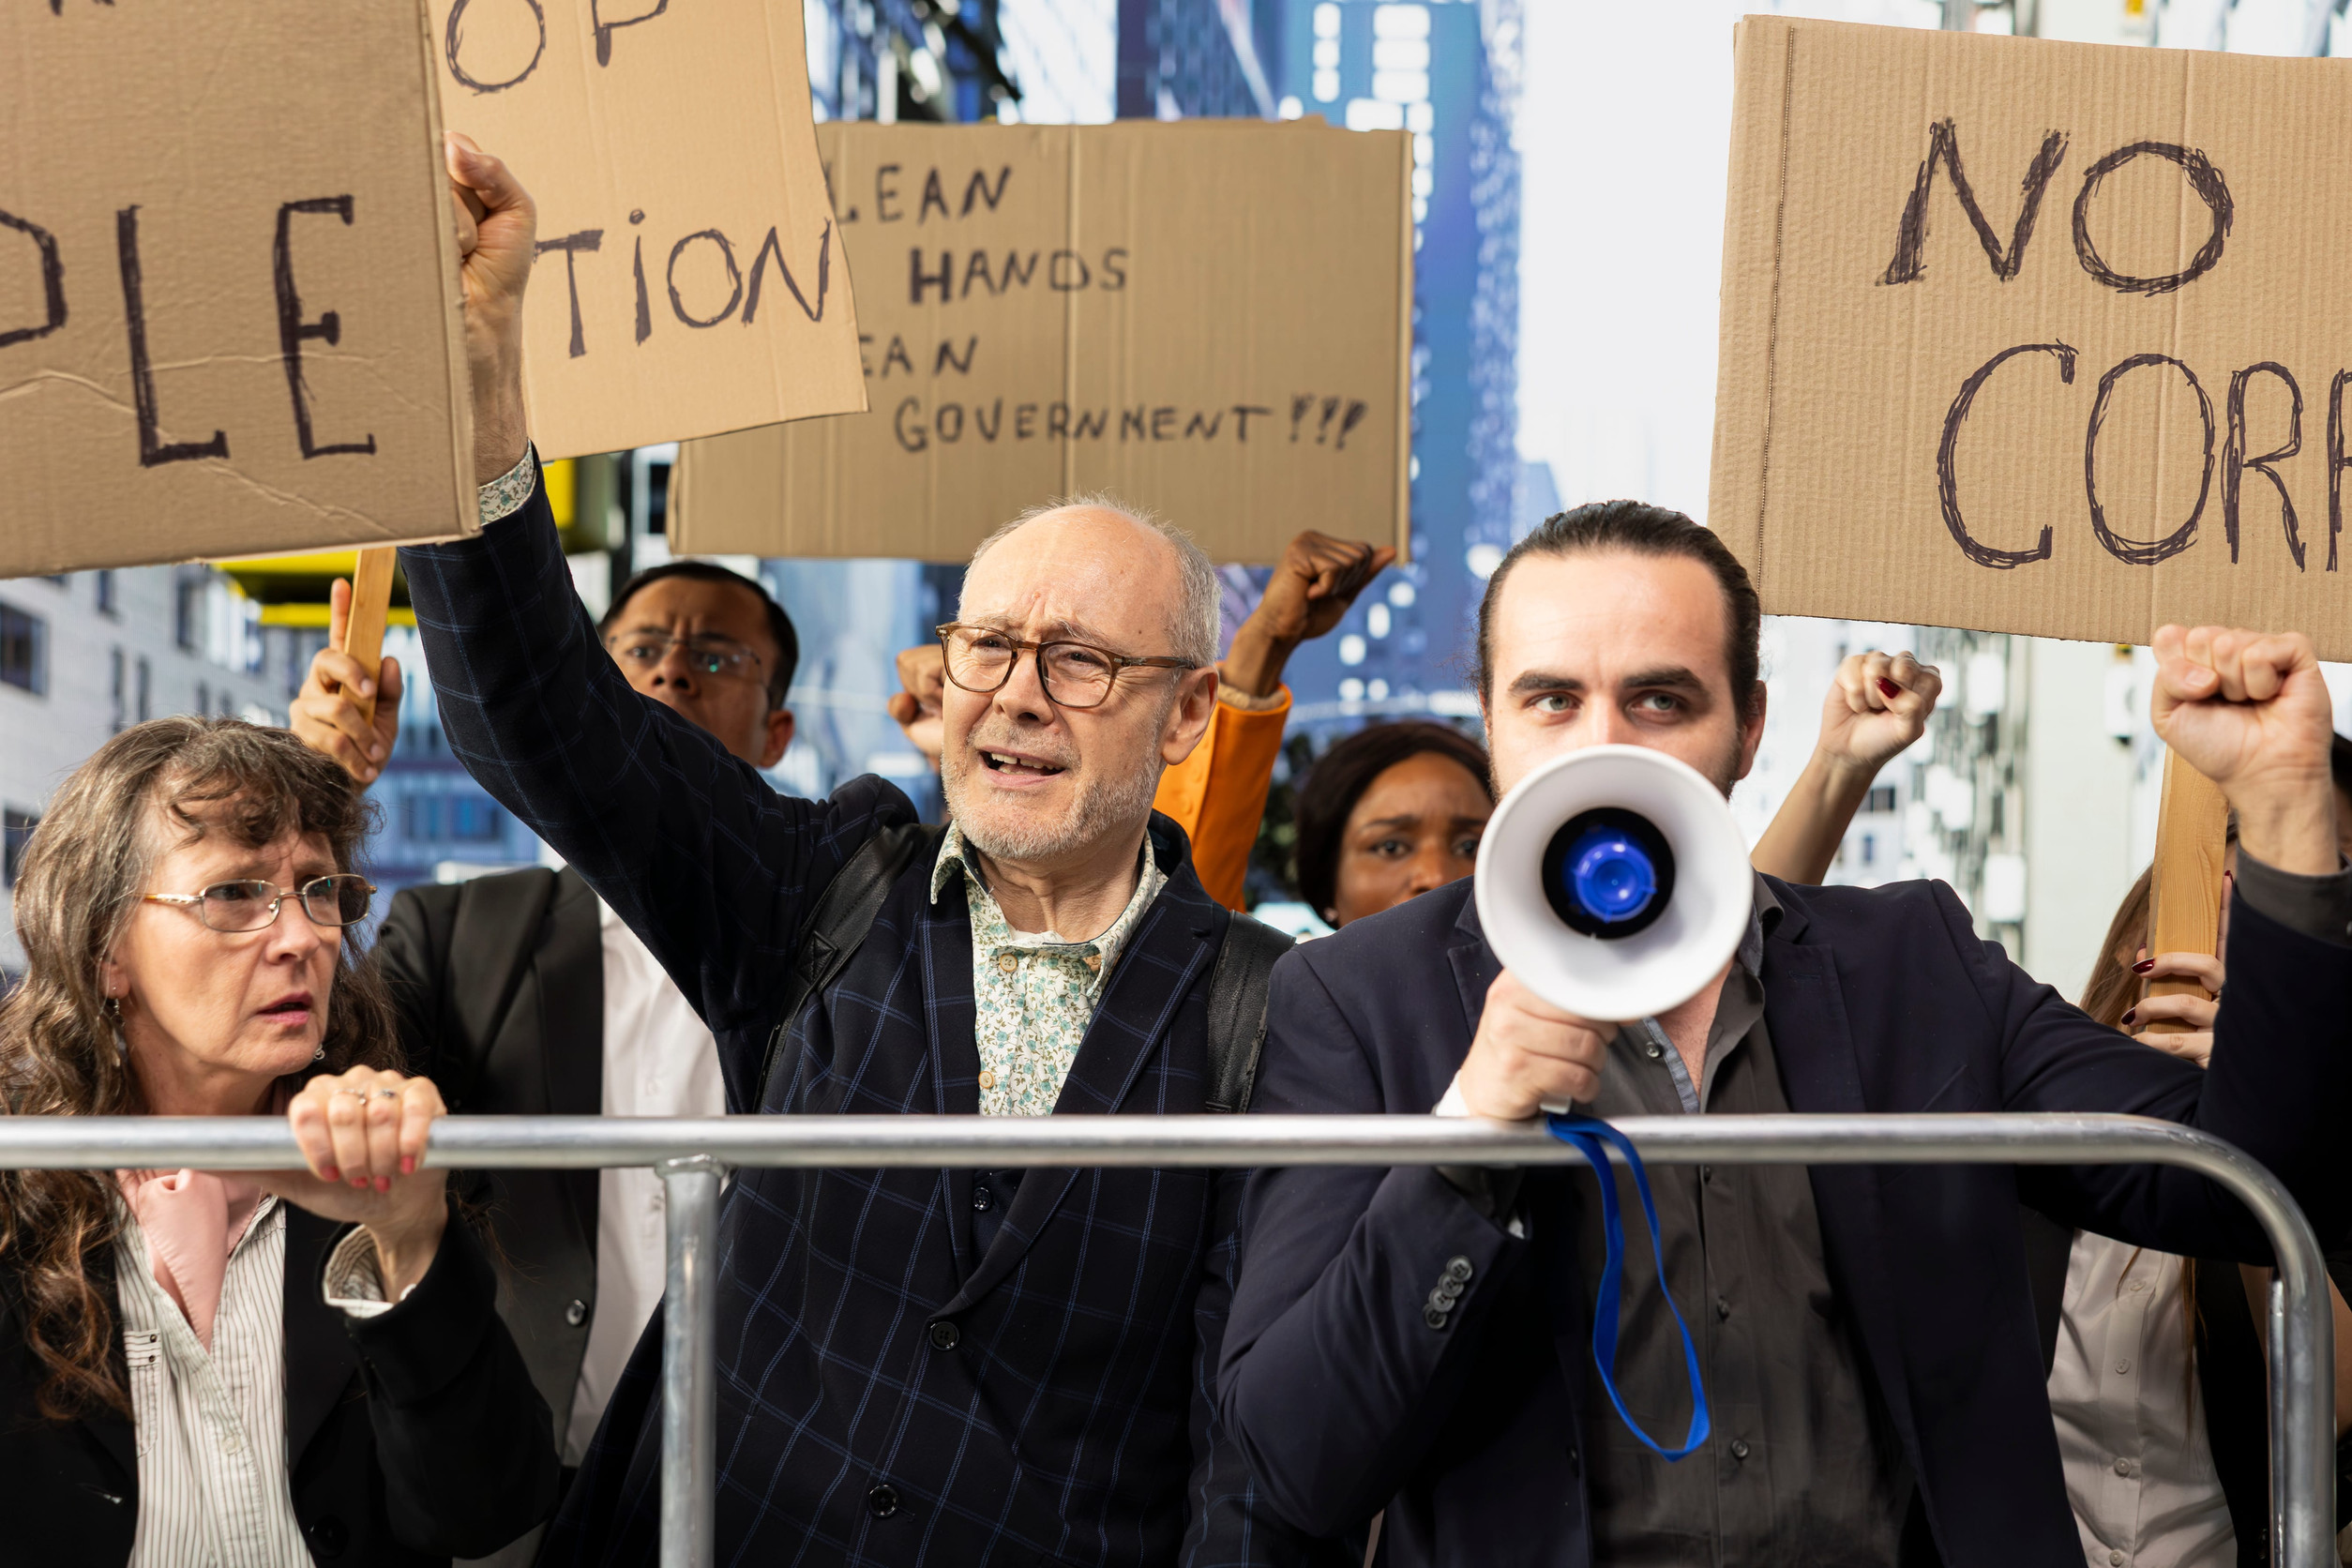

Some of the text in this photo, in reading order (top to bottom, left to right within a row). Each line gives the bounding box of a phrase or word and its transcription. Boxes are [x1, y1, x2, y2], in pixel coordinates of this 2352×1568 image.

[909, 247, 1127, 306] HANDS
[1875, 117, 2234, 296] NO
[1937, 339, 2352, 572] COR
